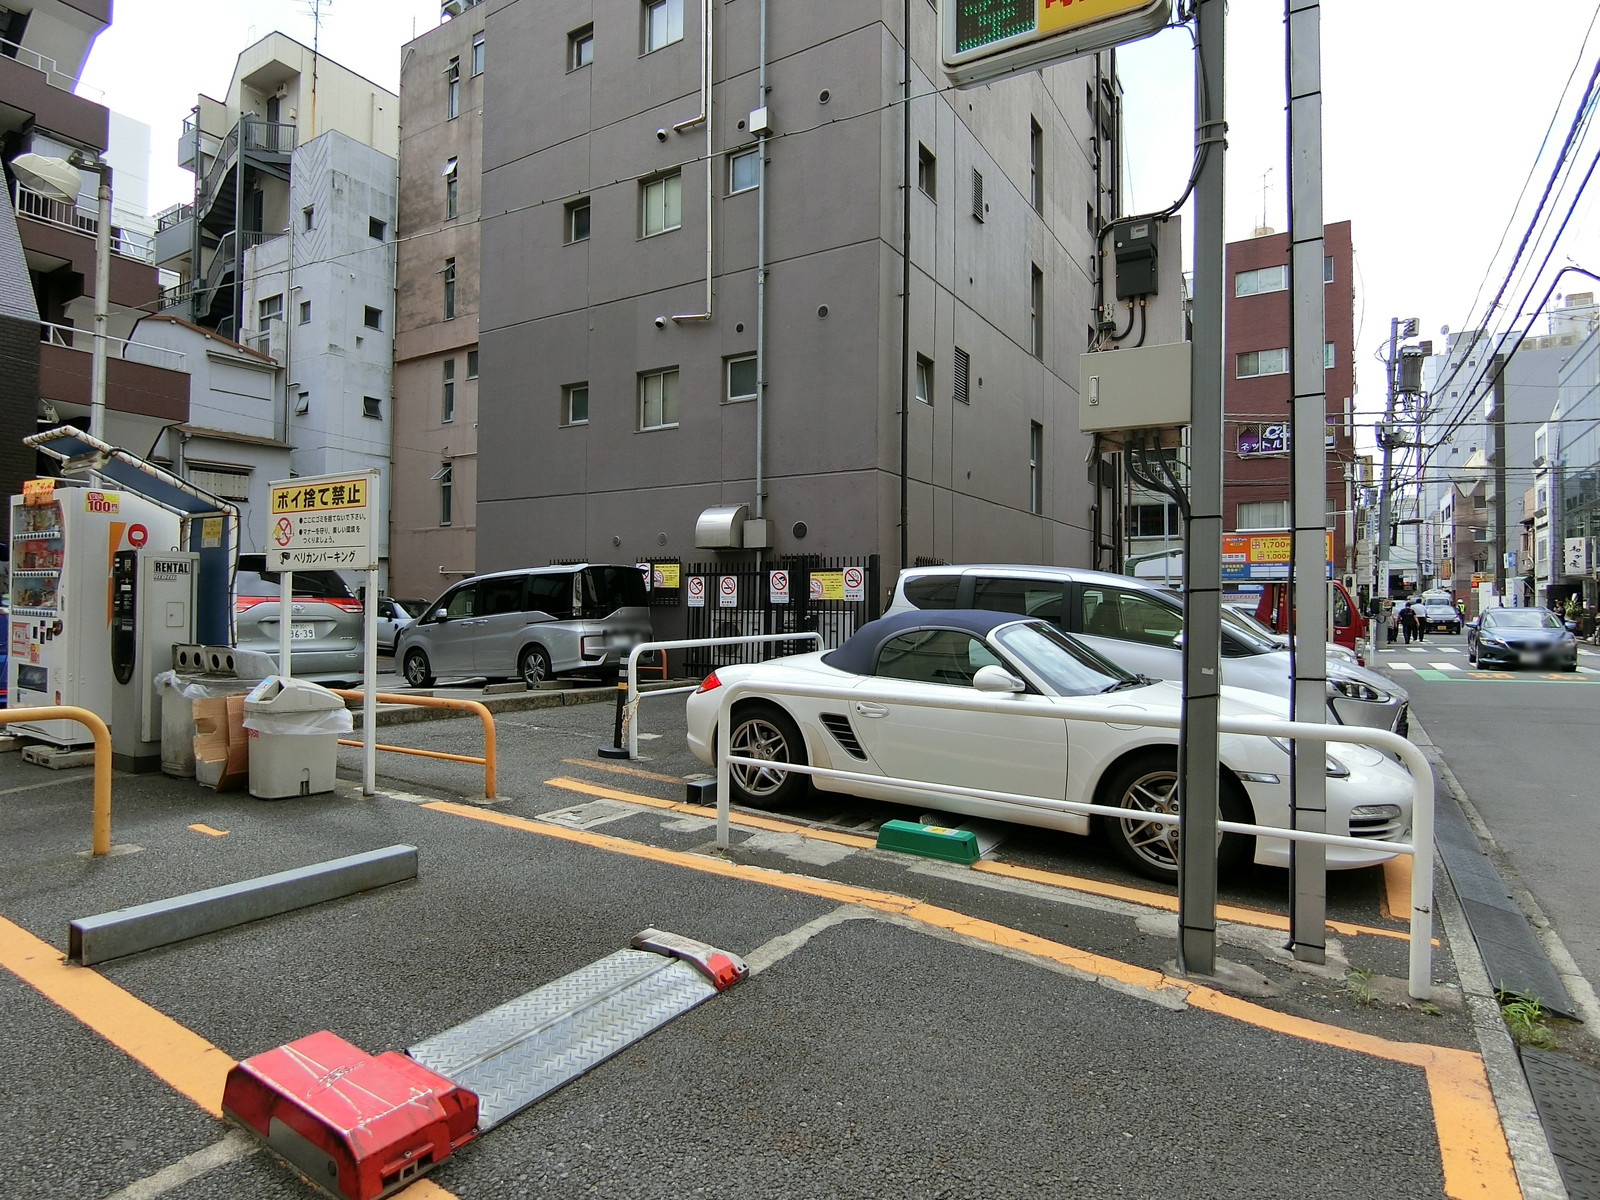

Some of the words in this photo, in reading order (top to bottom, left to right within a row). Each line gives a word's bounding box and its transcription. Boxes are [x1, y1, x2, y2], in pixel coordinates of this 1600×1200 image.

[1240, 439, 1290, 451] ネットル
[277, 483, 361, 510] ポイ捨て禁止
[303, 513, 367, 524] ここにゴミを捨てないで下さい。
[303, 525, 361, 536] マナーを守り、美しい環境を
[302, 536, 335, 544] つくりましょう。
[293, 550, 356, 564] ペリカンパーキング
[155, 562, 189, 573] RENTAL
